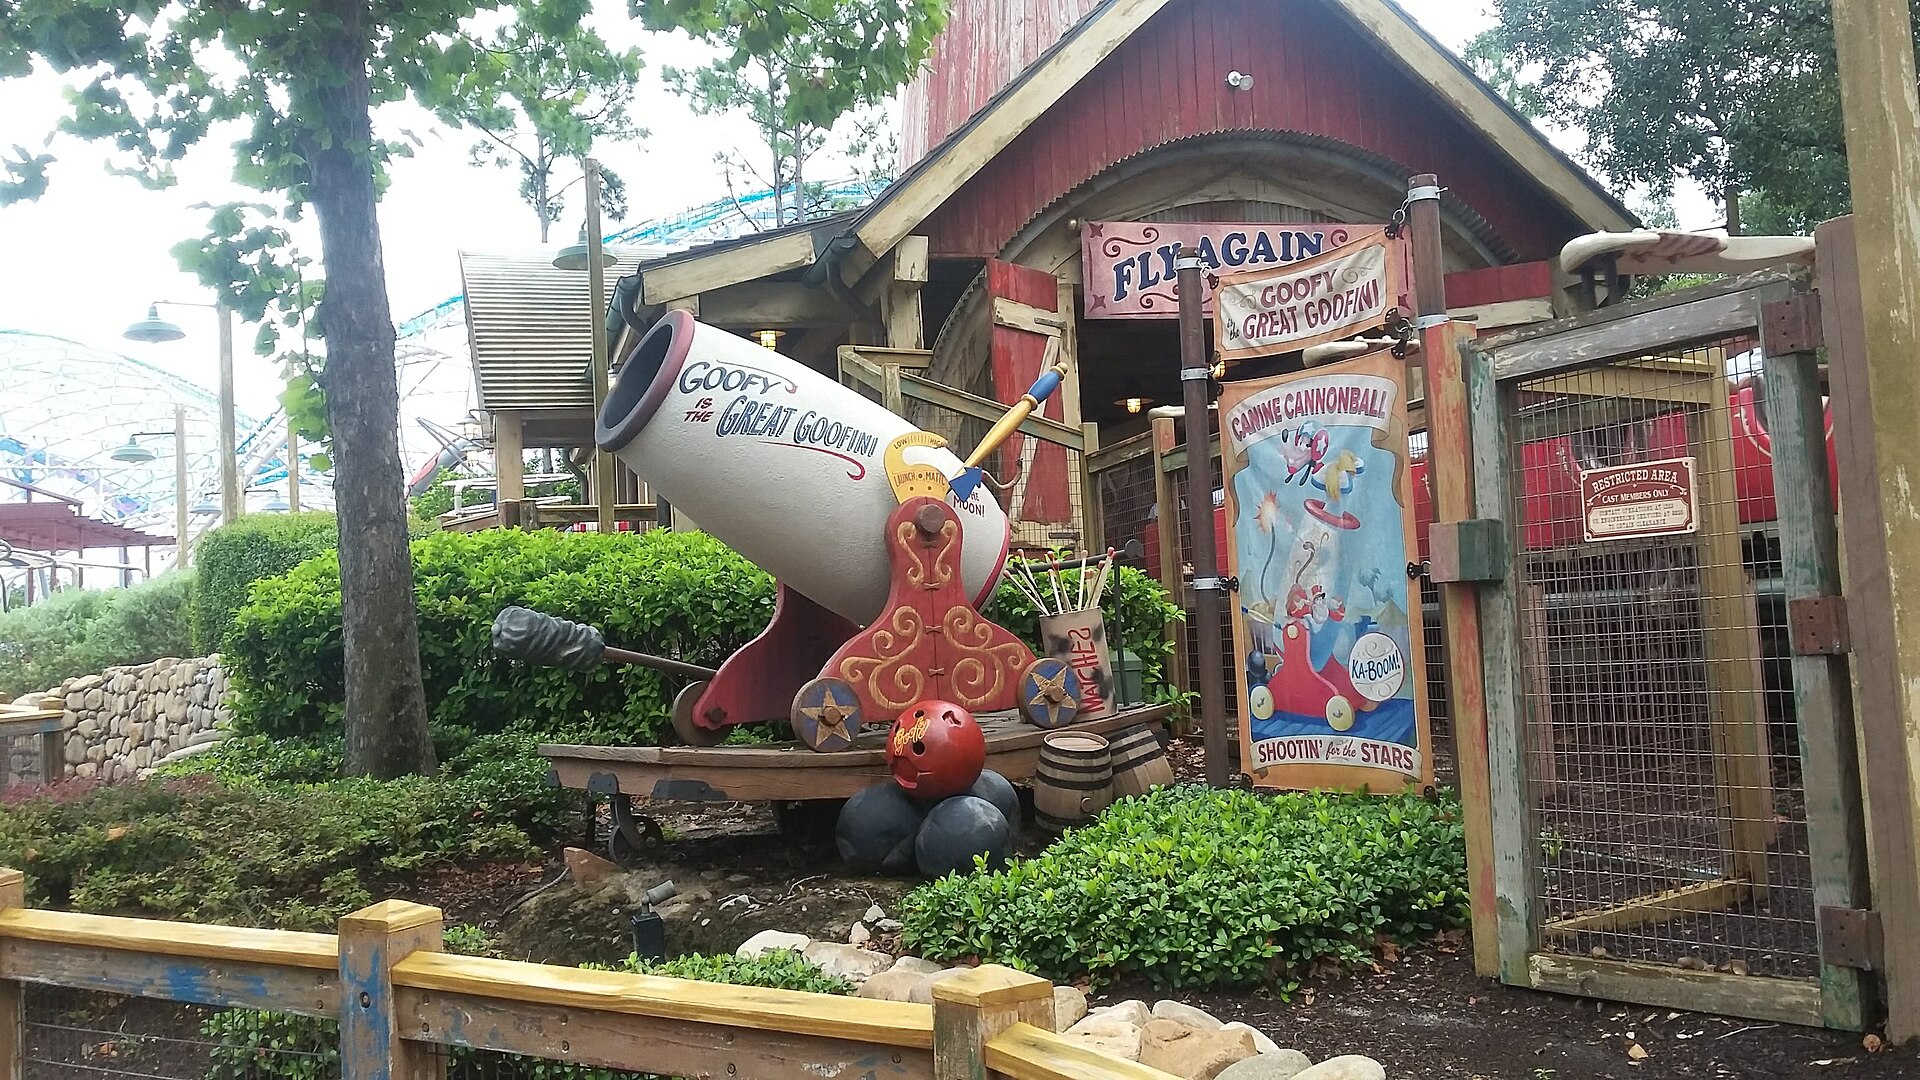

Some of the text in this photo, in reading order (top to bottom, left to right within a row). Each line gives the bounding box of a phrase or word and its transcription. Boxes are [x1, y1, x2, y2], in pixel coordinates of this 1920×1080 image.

[1112, 231, 1323, 301] FLY AGAIN
[1260, 268, 1338, 309] GOOFY
[1242, 305, 1298, 340] GREAT
[1304, 278, 1380, 328] GOOFINI
[679, 361, 781, 394] GOOFY
[695, 397, 713, 409] IS
[1231, 386, 1388, 442] CANINE CANNONBALL
[683, 395, 879, 457] THE GREAT GOOFINI
[893, 438, 908, 449] LOW
[1591, 469, 1678, 493] RESTRICTED AREA
[1602, 488, 1669, 504] CAST MEMBERS ONLY
[953, 495, 985, 517] MOON!
[1351, 649, 1401, 681] KA-BOOM!
[1259, 739, 1414, 771] SHOOTIN' for the STARS
